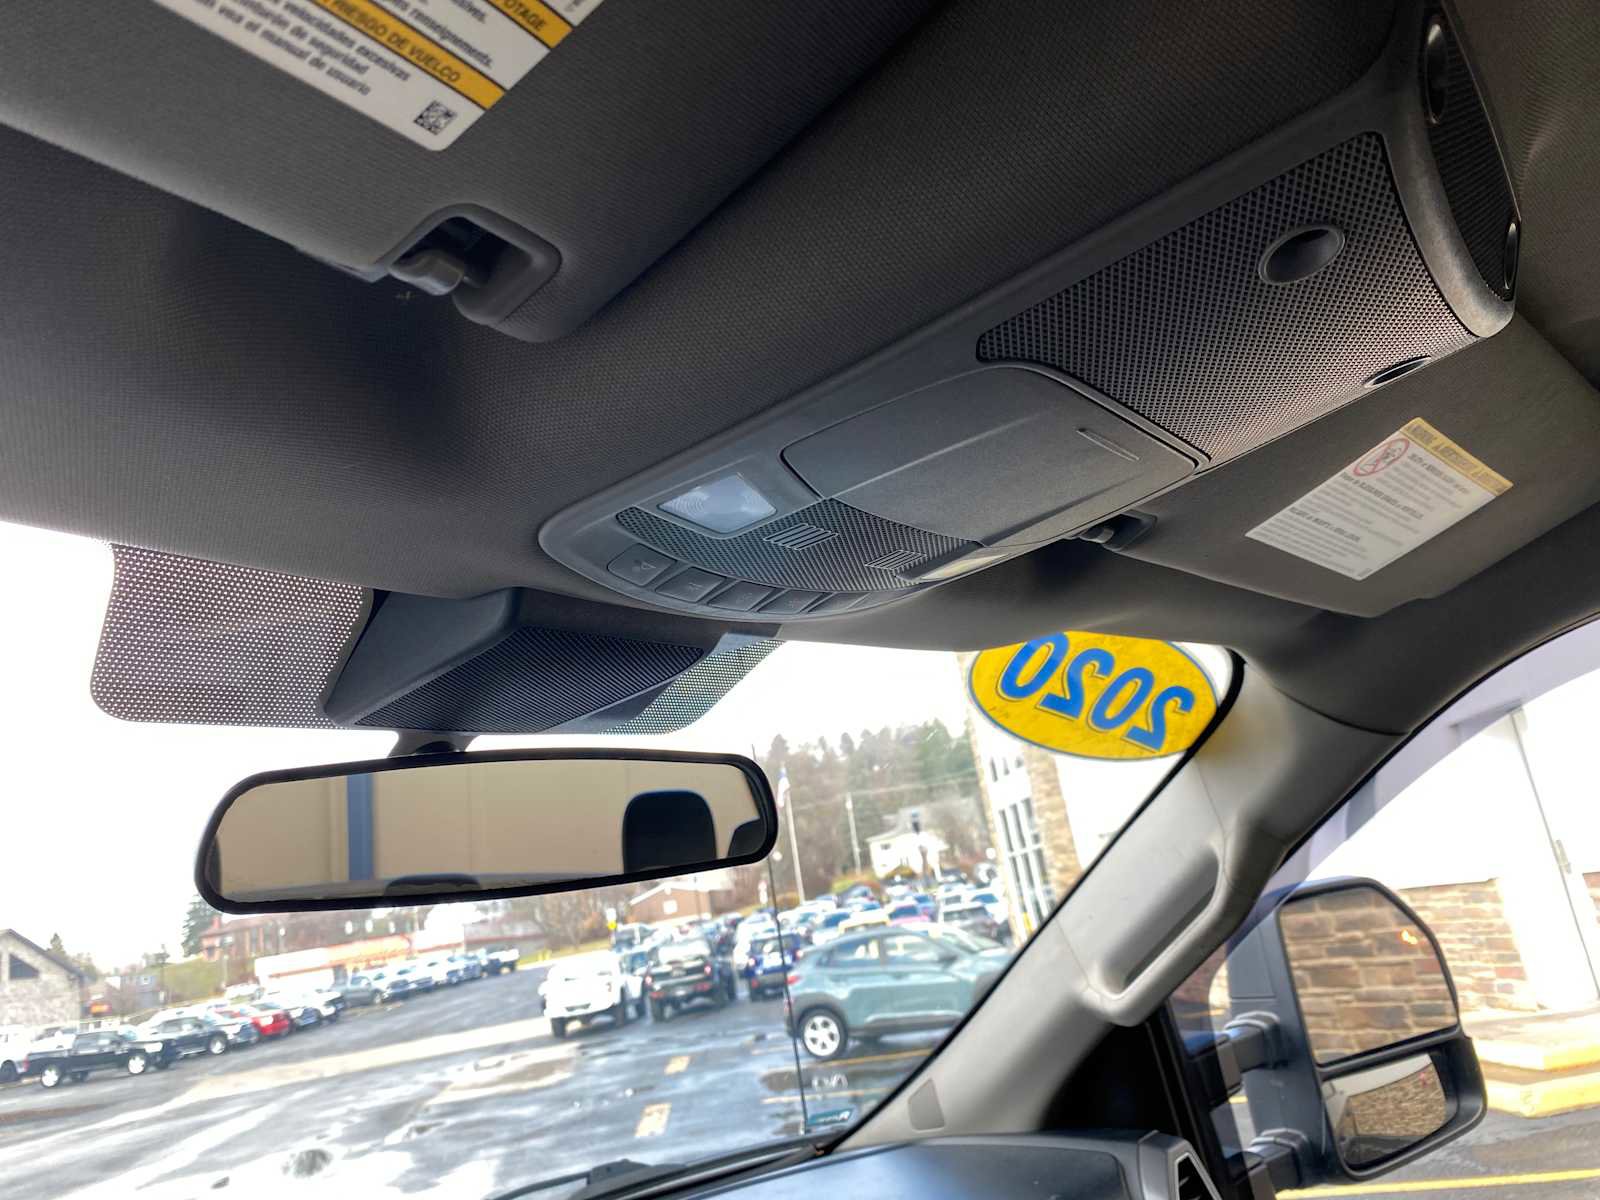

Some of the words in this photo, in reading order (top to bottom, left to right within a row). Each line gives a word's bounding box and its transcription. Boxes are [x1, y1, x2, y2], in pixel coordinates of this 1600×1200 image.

[308, 37, 370, 74] seguridad
[355, 45, 411, 81] excesivas
[387, 31, 409, 49] DE
[410, 43, 461, 83] VUELCO
